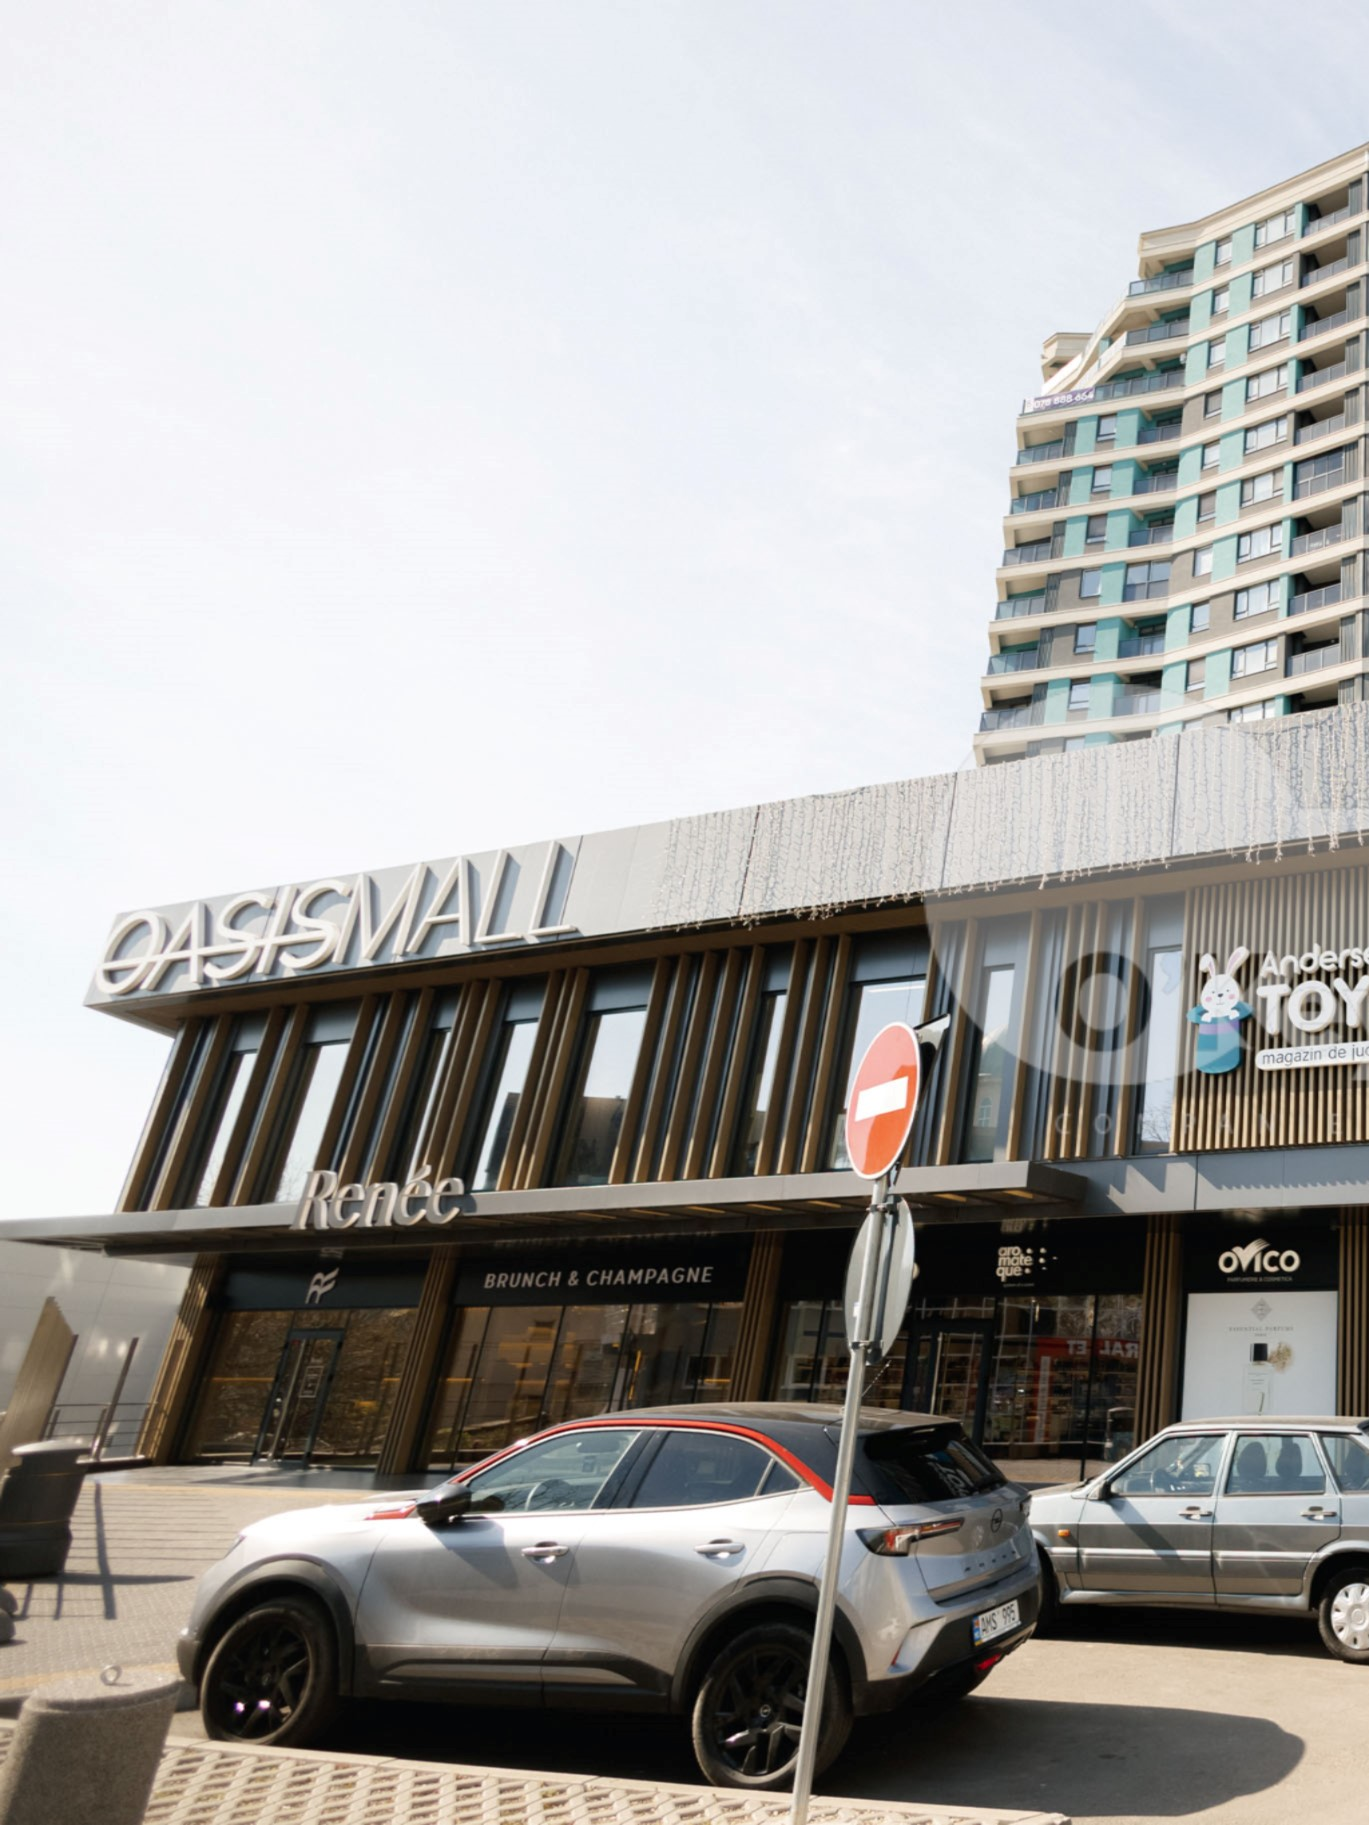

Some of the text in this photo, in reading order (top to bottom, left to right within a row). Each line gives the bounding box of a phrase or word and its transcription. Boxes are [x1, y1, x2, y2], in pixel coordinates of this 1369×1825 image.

[1261, 1049, 1323, 1067] magazin
[1328, 1045, 1347, 1061] de
[289, 1163, 465, 1231] Renée
[484, 1266, 714, 1289] BRUNCH & CHAMPAGNE
